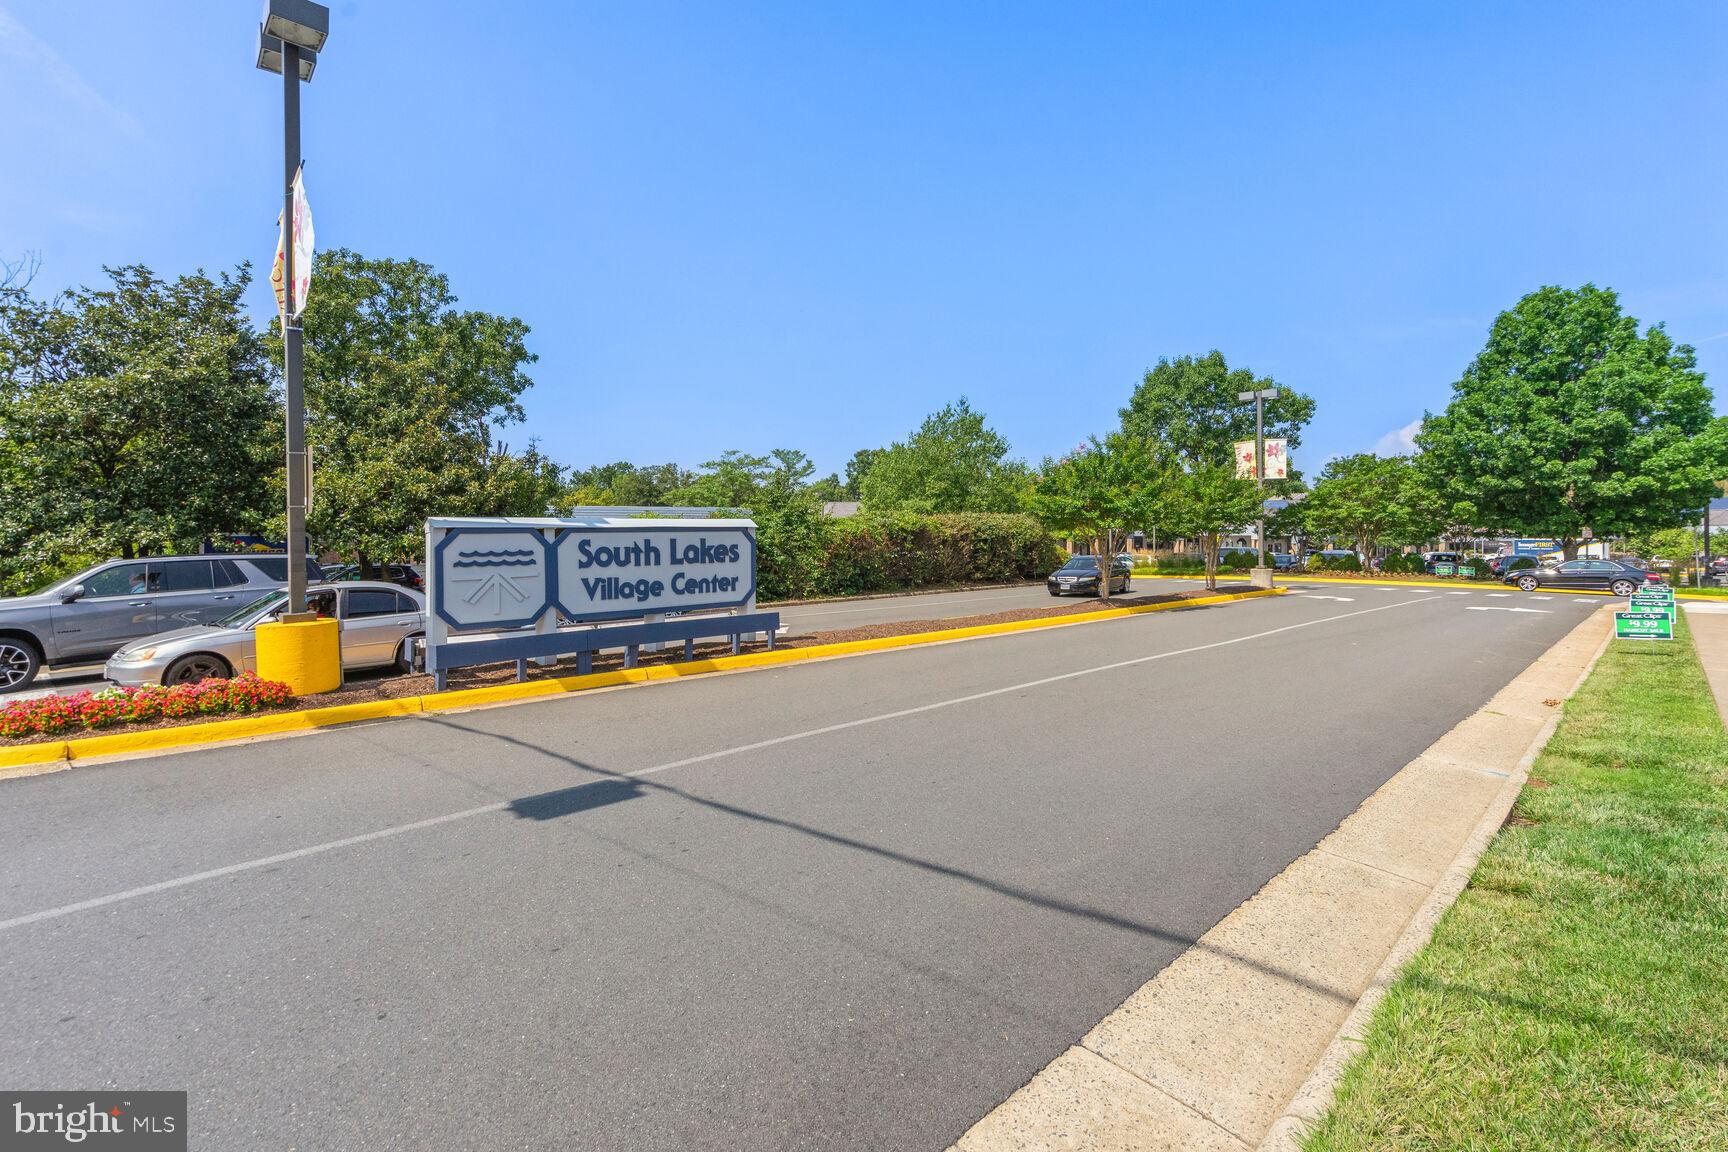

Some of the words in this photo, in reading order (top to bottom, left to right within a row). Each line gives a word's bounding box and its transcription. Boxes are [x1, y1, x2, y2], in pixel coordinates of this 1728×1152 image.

[578, 538, 661, 569] South
[669, 538, 740, 565] Lakes
[581, 577, 664, 602] Village
[671, 572, 739, 595] Center
[1628, 620, 1658, 628] $9.99
